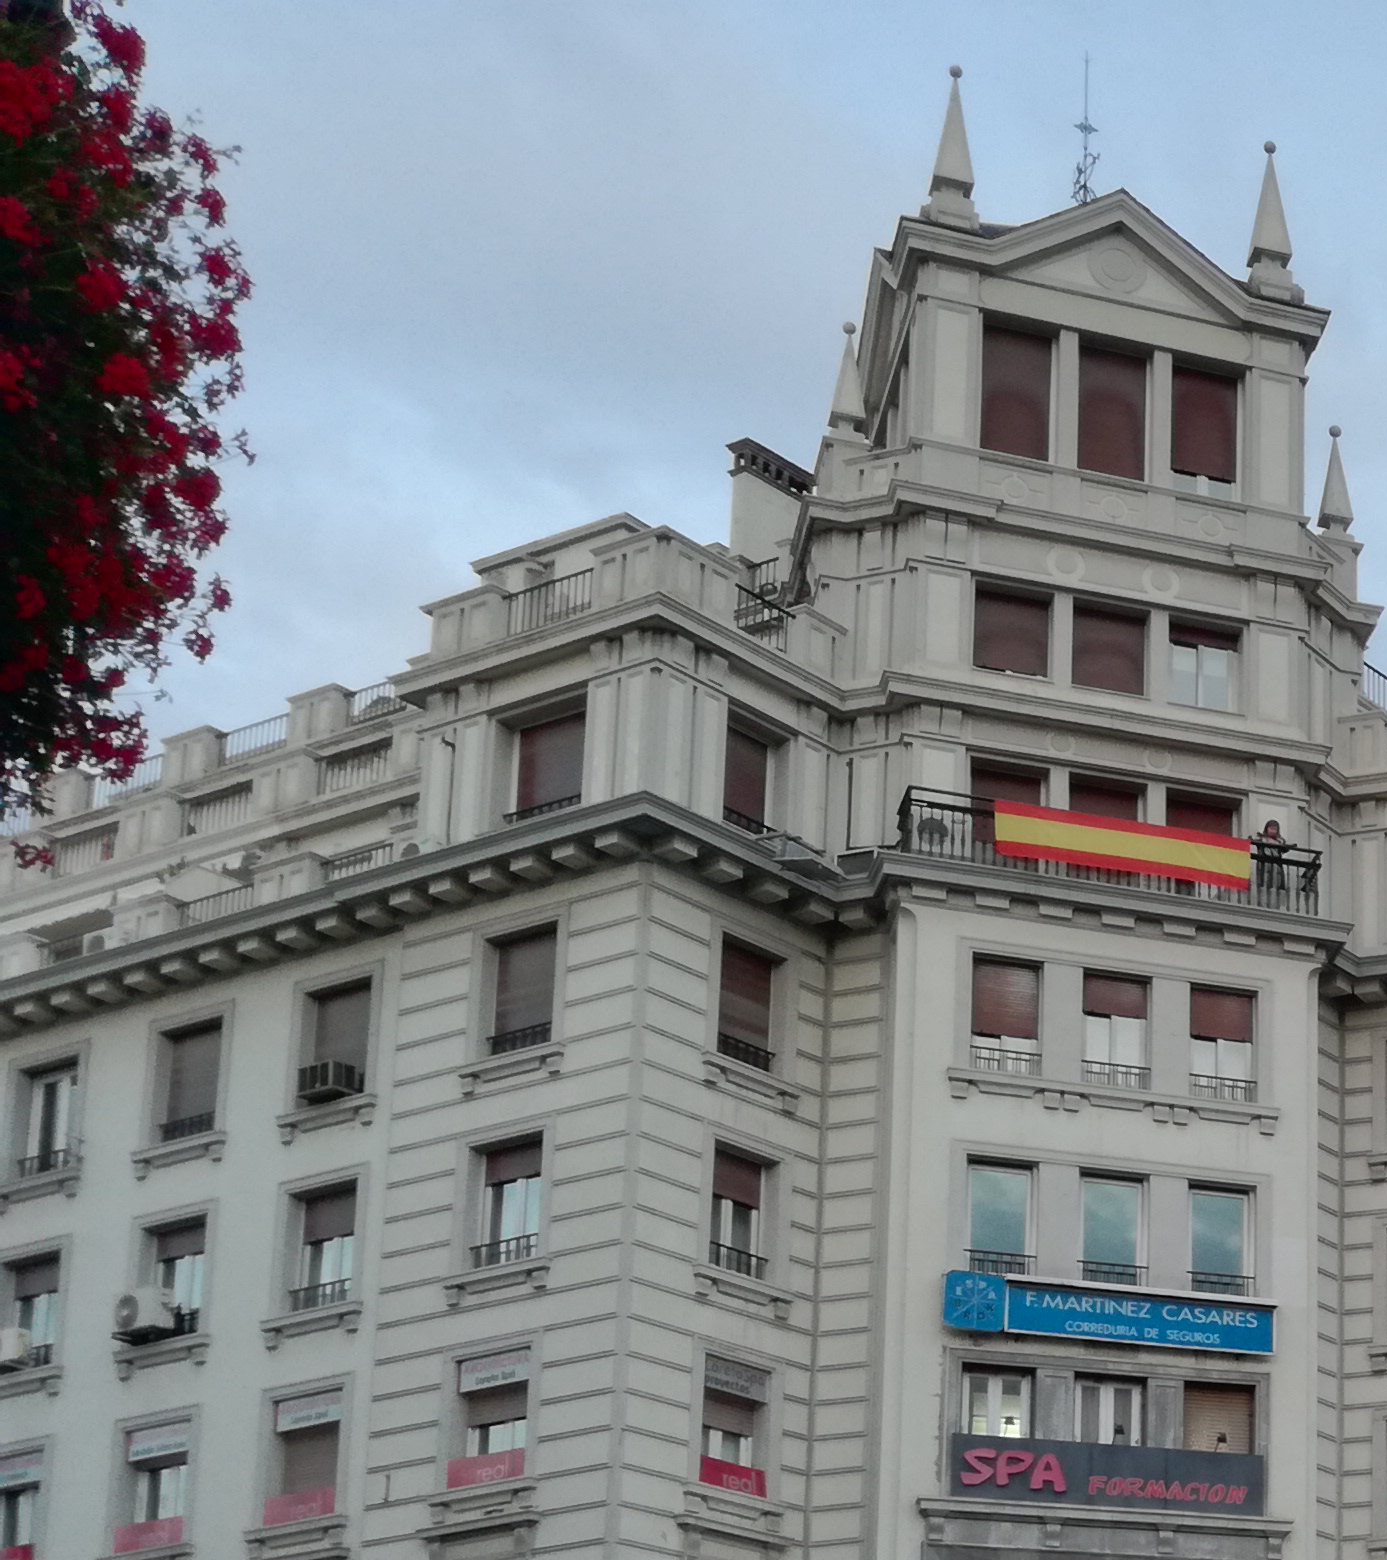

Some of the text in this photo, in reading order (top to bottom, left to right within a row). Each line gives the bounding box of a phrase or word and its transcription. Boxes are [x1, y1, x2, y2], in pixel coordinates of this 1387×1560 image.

[1162, 1304, 1259, 1328] CASARES
[1065, 1321, 1220, 1345] CORREDURIA DE SEGUROS
[476, 1455, 508, 1482] real
[960, 1447, 1248, 1505] SPA FORMACION
[721, 1471, 756, 1495] real
